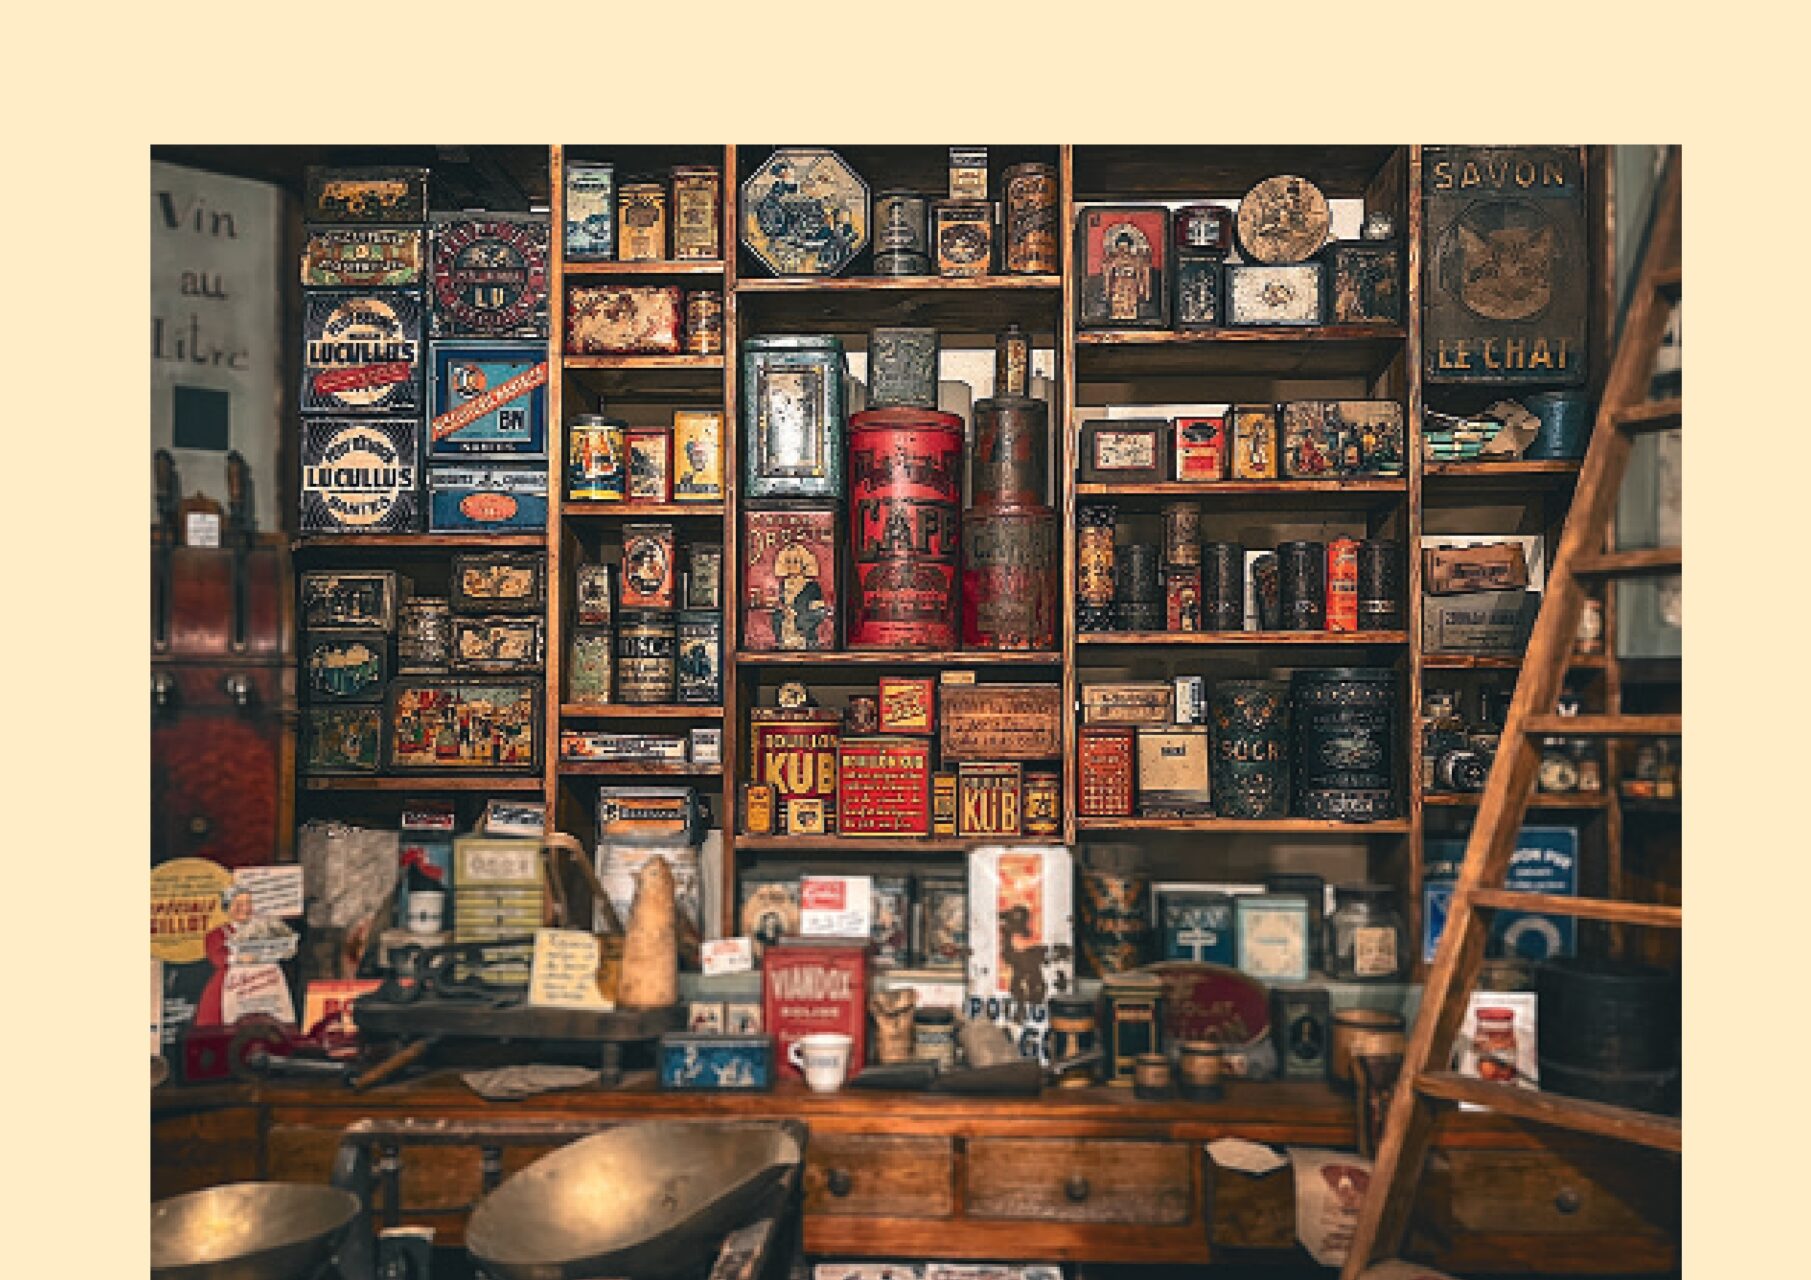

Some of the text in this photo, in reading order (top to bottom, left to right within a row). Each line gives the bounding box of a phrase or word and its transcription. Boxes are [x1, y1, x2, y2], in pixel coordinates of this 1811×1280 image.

[1433, 161, 1564, 189] SAVON
[155, 191, 239, 240] Vin
[180, 271, 229, 300] au
[153, 314, 249, 370] Litre
[309, 341, 415, 364] LUCULLUS
[1438, 336, 1571, 369] LE CHAT
[307, 467, 413, 488] LUCULLUS
[764, 752, 837, 794] KUB
[963, 789, 1018, 831] KUB
[770, 965, 853, 1001] VIANDOX
